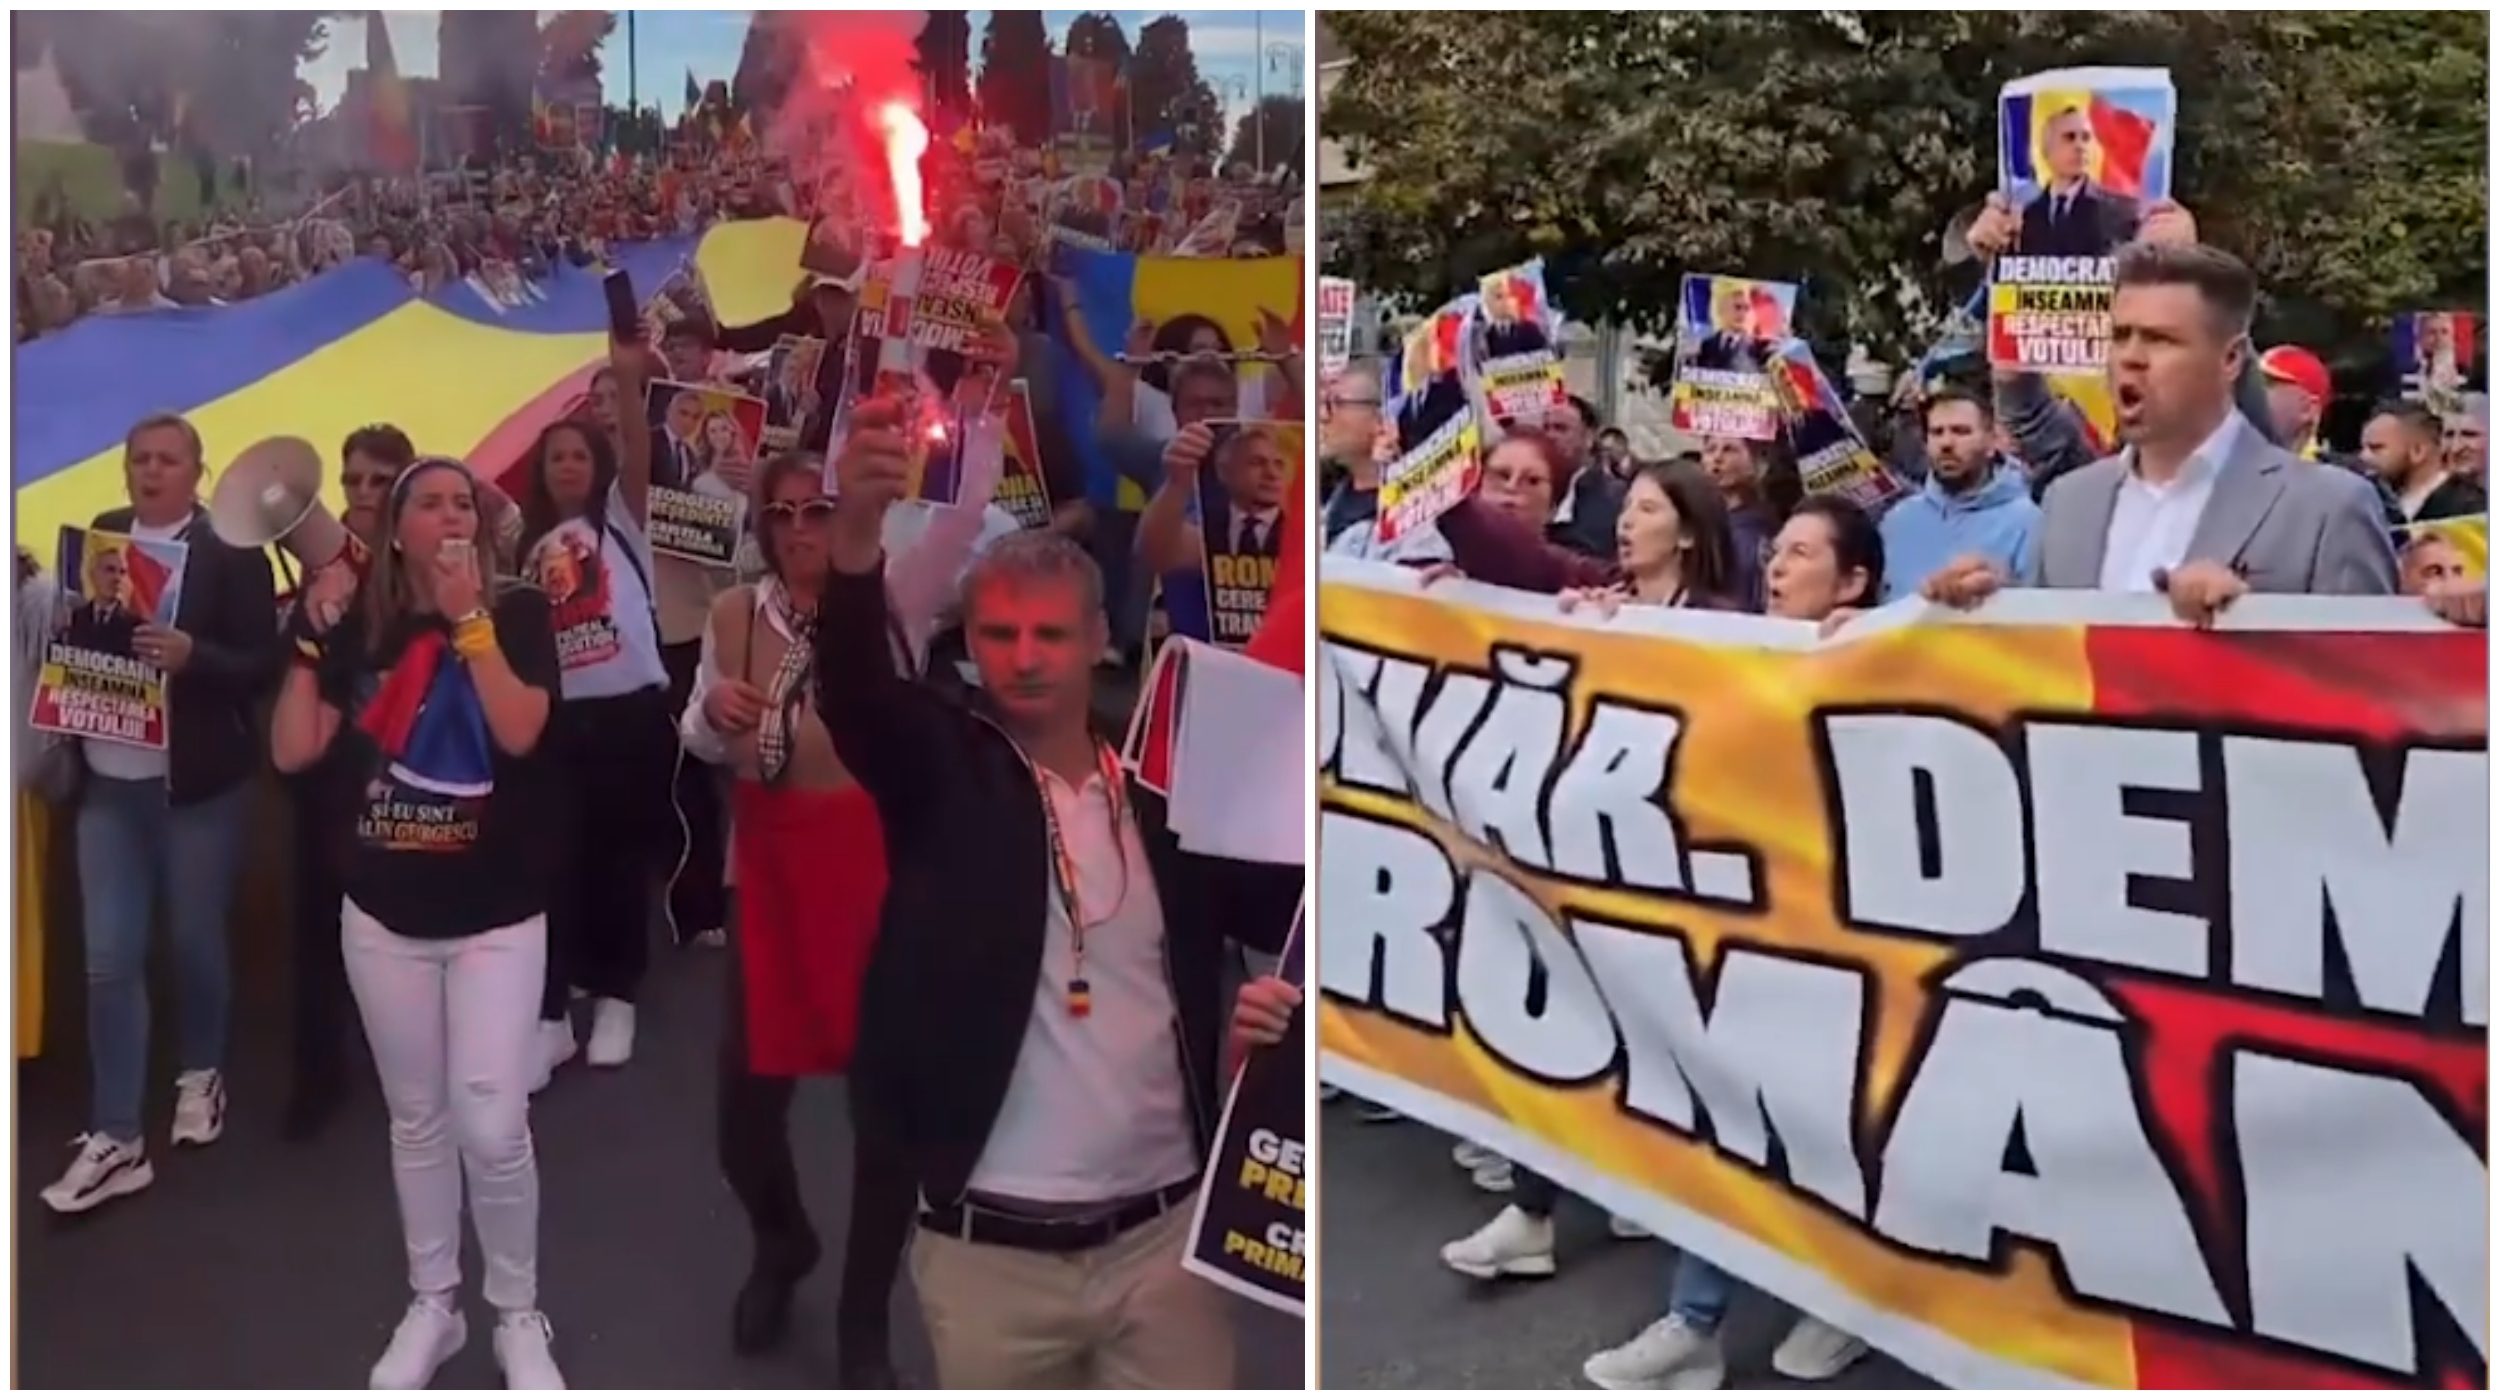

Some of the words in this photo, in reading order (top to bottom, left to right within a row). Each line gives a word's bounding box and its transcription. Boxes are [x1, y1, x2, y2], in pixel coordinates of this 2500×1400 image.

[1999, 256, 2117, 282] DEMOCRA
[2003, 312, 2112, 337] RESPECTA
[1213, 554, 1279, 588] ROM
[1249, 1128, 1305, 1174] GE
[1224, 1230, 1305, 1282] PRIM
